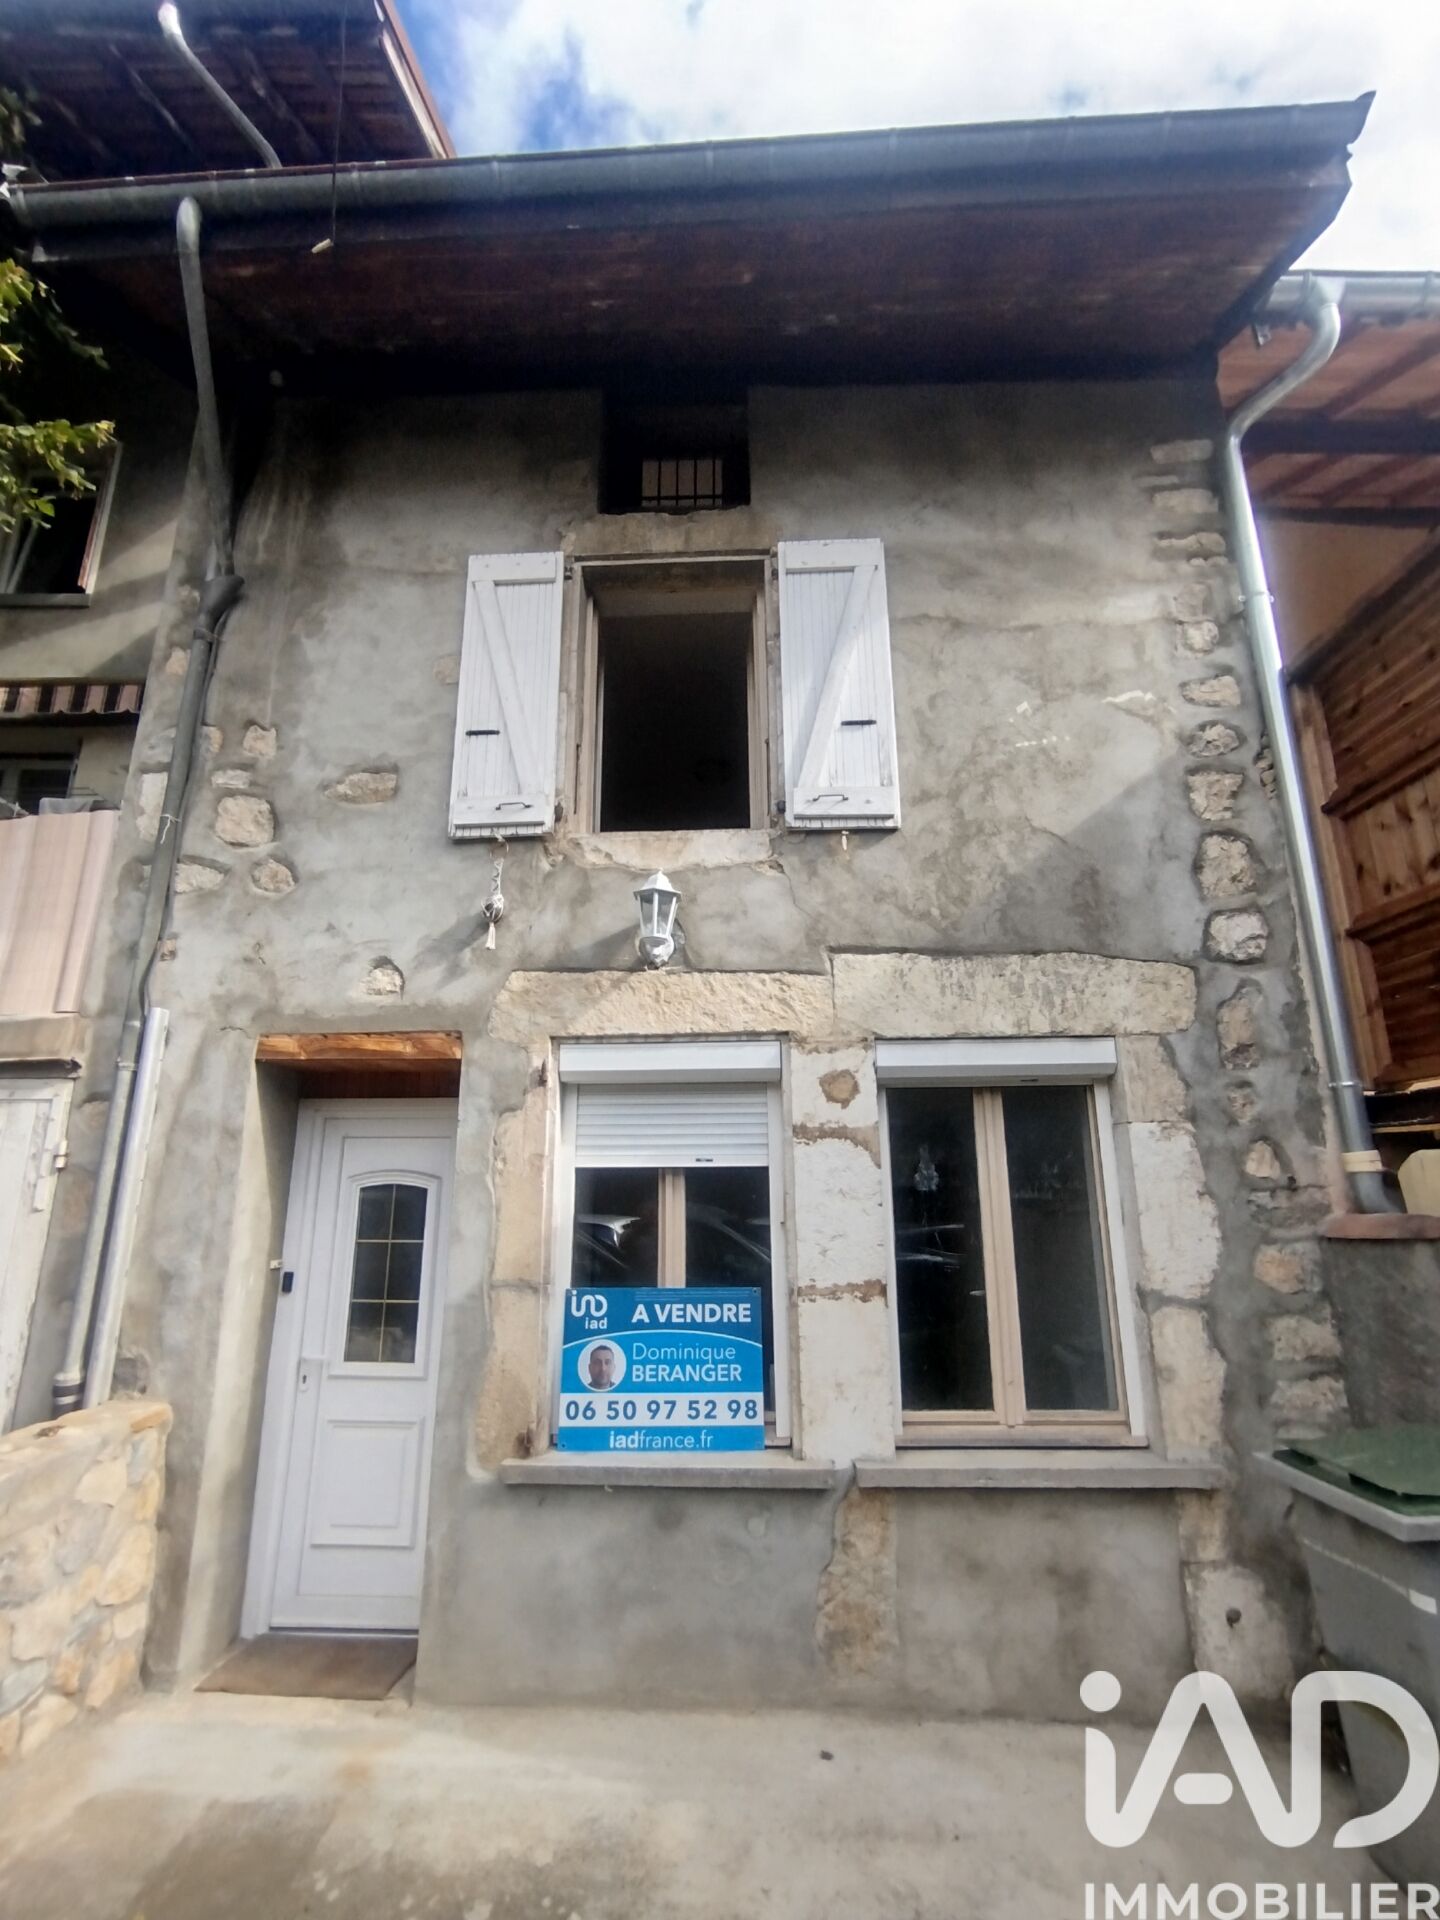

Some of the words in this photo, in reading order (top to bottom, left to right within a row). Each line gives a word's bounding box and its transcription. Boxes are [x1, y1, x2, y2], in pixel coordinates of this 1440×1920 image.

[631, 1303, 650, 1323] A
[654, 1303, 752, 1323] VENDRE
[585, 1317, 608, 1330] iad
[632, 1343, 736, 1364] Dominique
[632, 1364, 742, 1383] BERANGER
[565, 1400, 596, 1421] 06
[606, 1400, 637, 1420] 50
[646, 1400, 677, 1420] 97
[687, 1400, 718, 1420] 52
[727, 1399, 758, 1420] 98
[609, 1430, 714, 1449] iadfrance.fr
